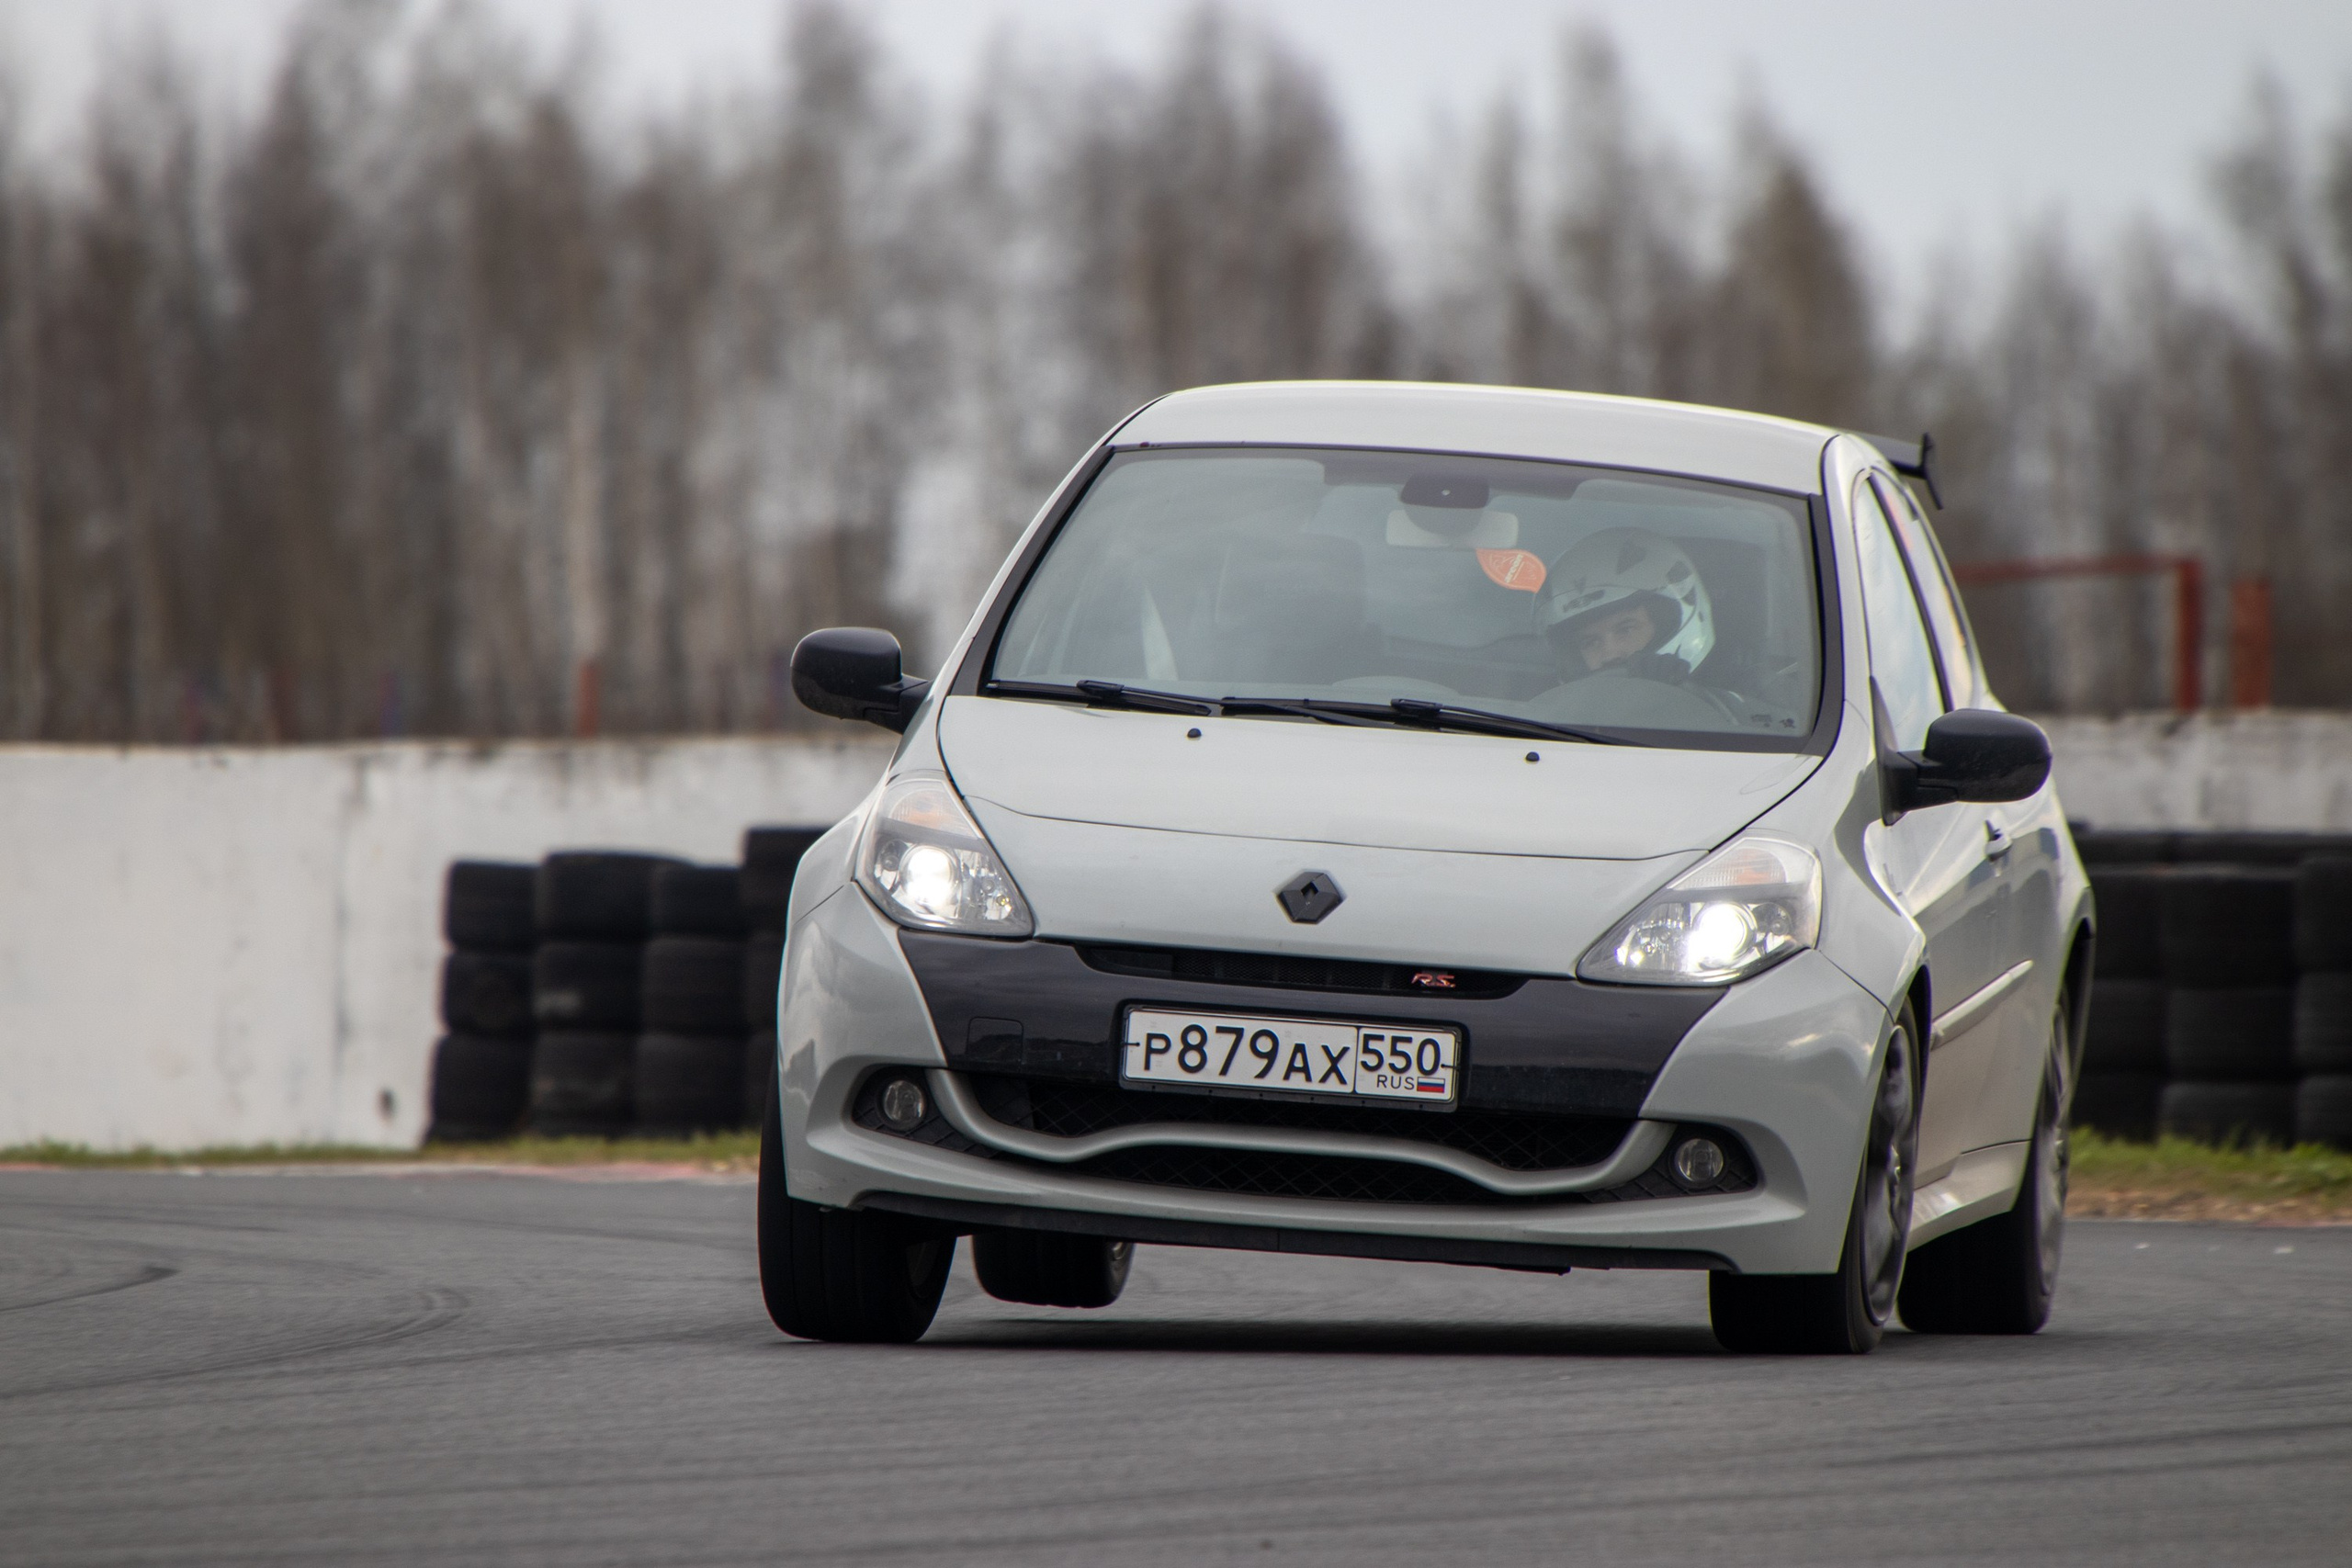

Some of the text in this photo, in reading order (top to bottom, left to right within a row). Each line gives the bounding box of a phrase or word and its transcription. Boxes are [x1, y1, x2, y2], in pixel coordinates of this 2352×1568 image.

[1144, 1024, 1441, 1085] P879AX 550
[1376, 1074, 1415, 1090] RUS
